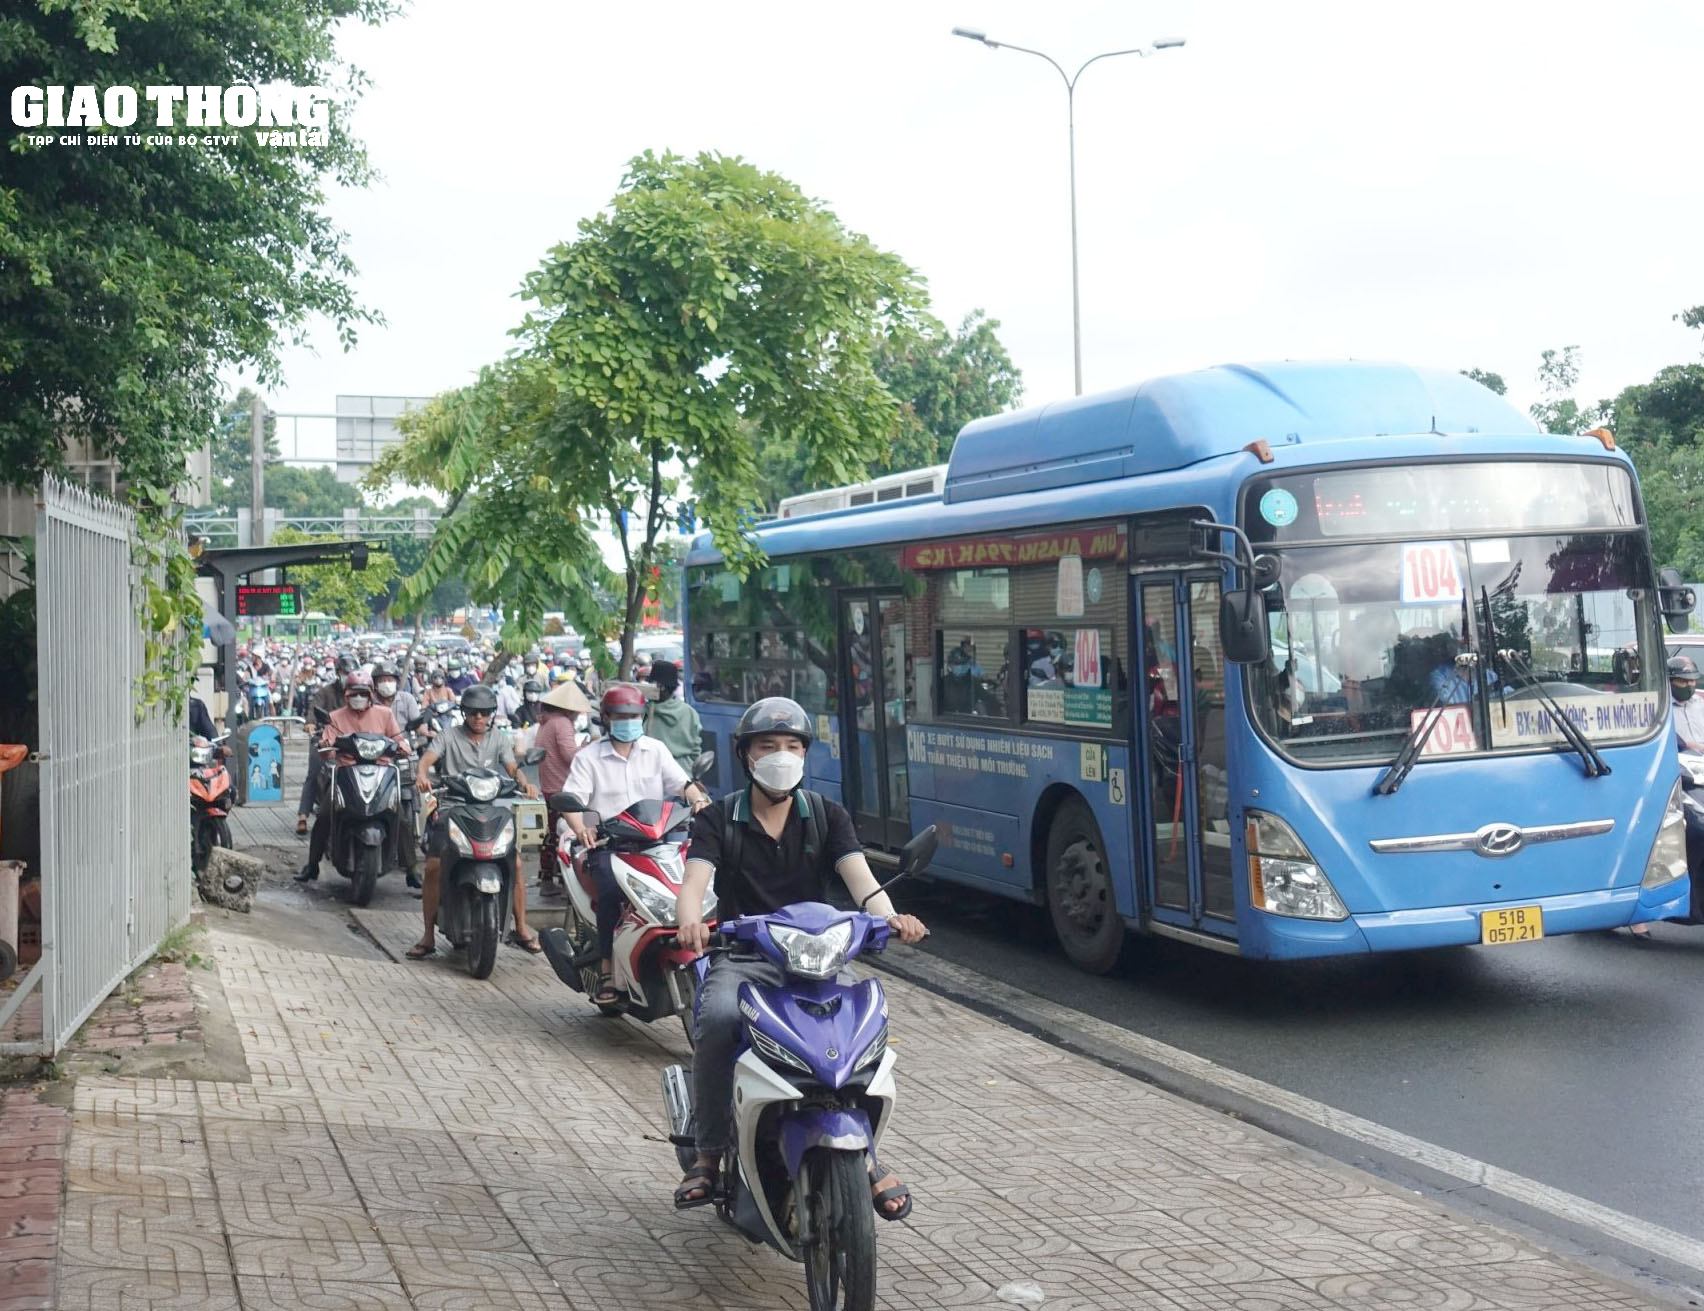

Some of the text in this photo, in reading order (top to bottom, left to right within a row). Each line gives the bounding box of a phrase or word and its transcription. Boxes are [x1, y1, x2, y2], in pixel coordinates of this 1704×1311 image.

[1406, 548, 1457, 598] 104
[1075, 629, 1100, 685] 104
[1516, 711, 1536, 736] BX:
[1537, 709, 1553, 735] AN
[1597, 705, 1611, 731] ĐH
[1613, 697, 1637, 729] NÔNG
[1638, 696, 1656, 728] LÂM
[1031, 743, 1053, 762] SẠCH
[1499, 909, 1525, 926] 51B
[1489, 925, 1535, 943] 057.21
